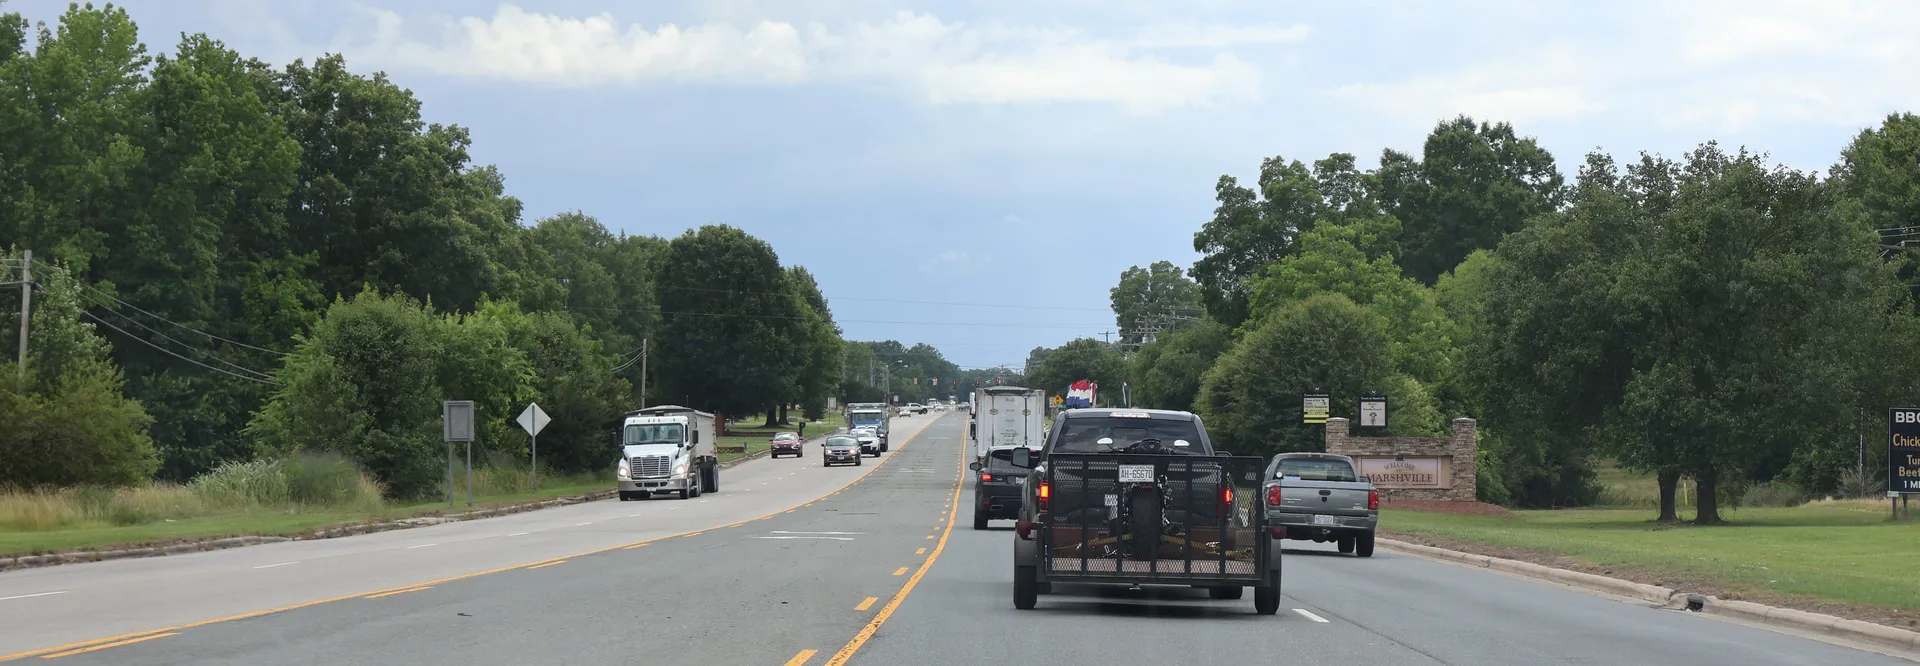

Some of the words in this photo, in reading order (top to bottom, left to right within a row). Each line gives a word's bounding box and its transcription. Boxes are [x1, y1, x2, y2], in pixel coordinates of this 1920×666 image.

[1895, 411, 1920, 423] BB
[1893, 433, 1920, 447] Chick
[1384, 462, 1416, 471] WELCOME
[1120, 469, 1153, 478] AH-65670
[1366, 473, 1433, 483] MARSHVILLE
[1904, 480, 1908, 489] 1
